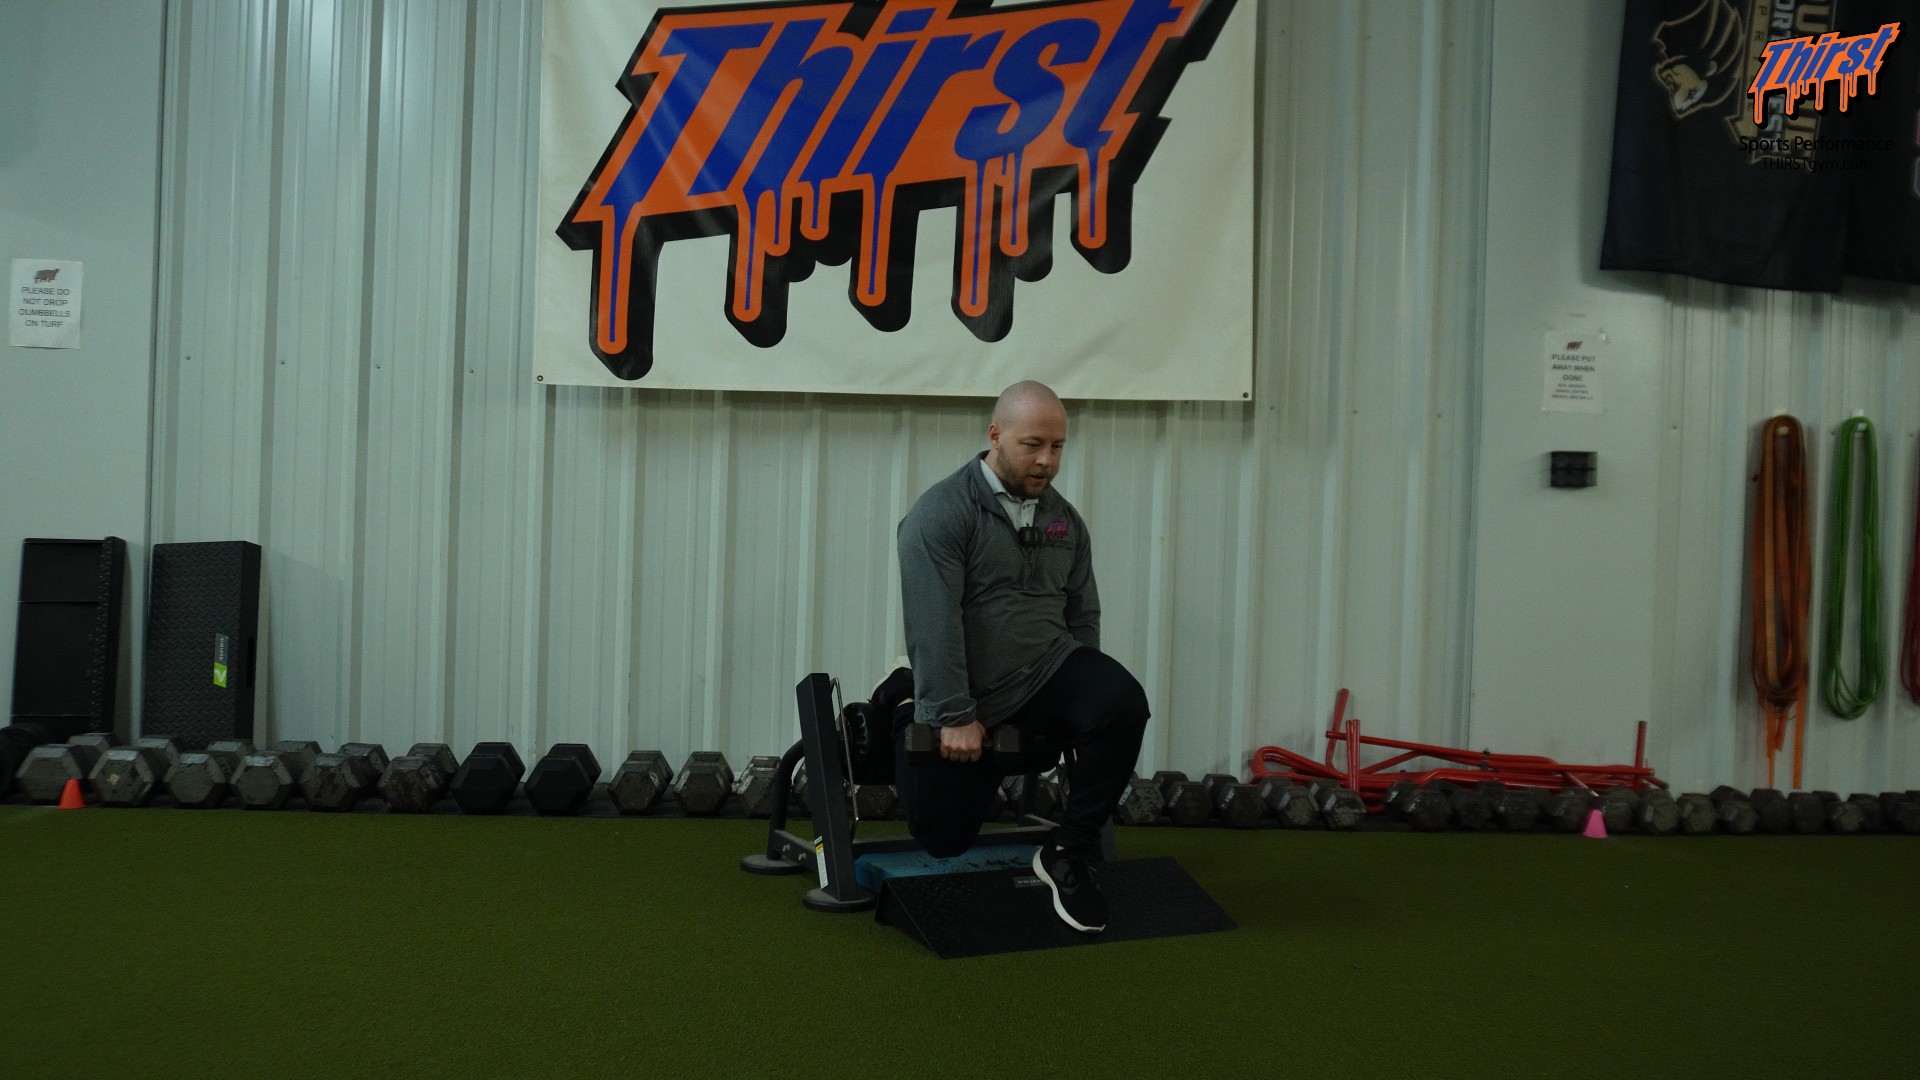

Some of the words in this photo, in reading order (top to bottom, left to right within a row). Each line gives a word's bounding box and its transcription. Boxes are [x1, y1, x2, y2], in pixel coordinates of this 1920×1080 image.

[580, 0, 1200, 270] Thirst
[22, 287, 55, 295] PLEASE
[19, 308, 71, 317] DUMBBELLS
[1552, 353, 1580, 361] PLEASE
